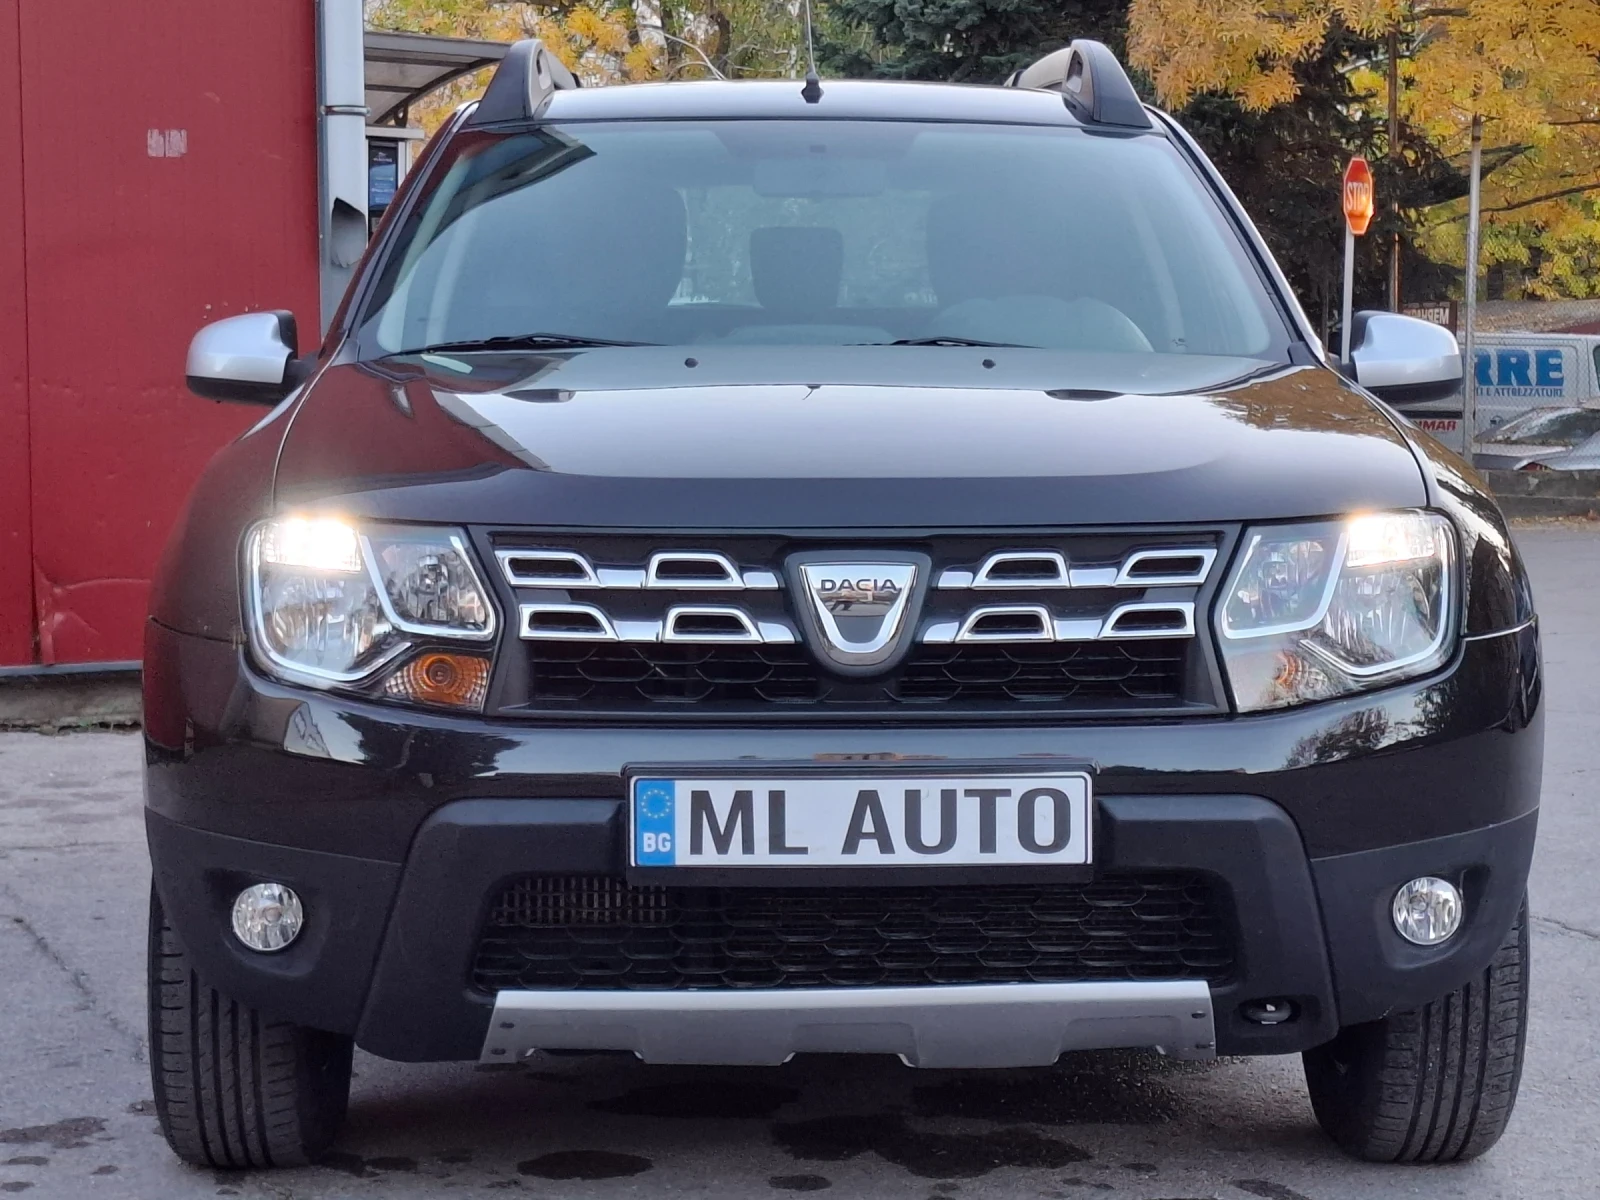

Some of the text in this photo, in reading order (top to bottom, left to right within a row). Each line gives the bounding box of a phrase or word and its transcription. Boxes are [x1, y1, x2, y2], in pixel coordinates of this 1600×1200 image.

[1346, 182, 1370, 211] STOP
[821, 579, 898, 592] DACIA
[689, 787, 1072, 856] ML AUTO
[643, 832, 671, 853] BG
